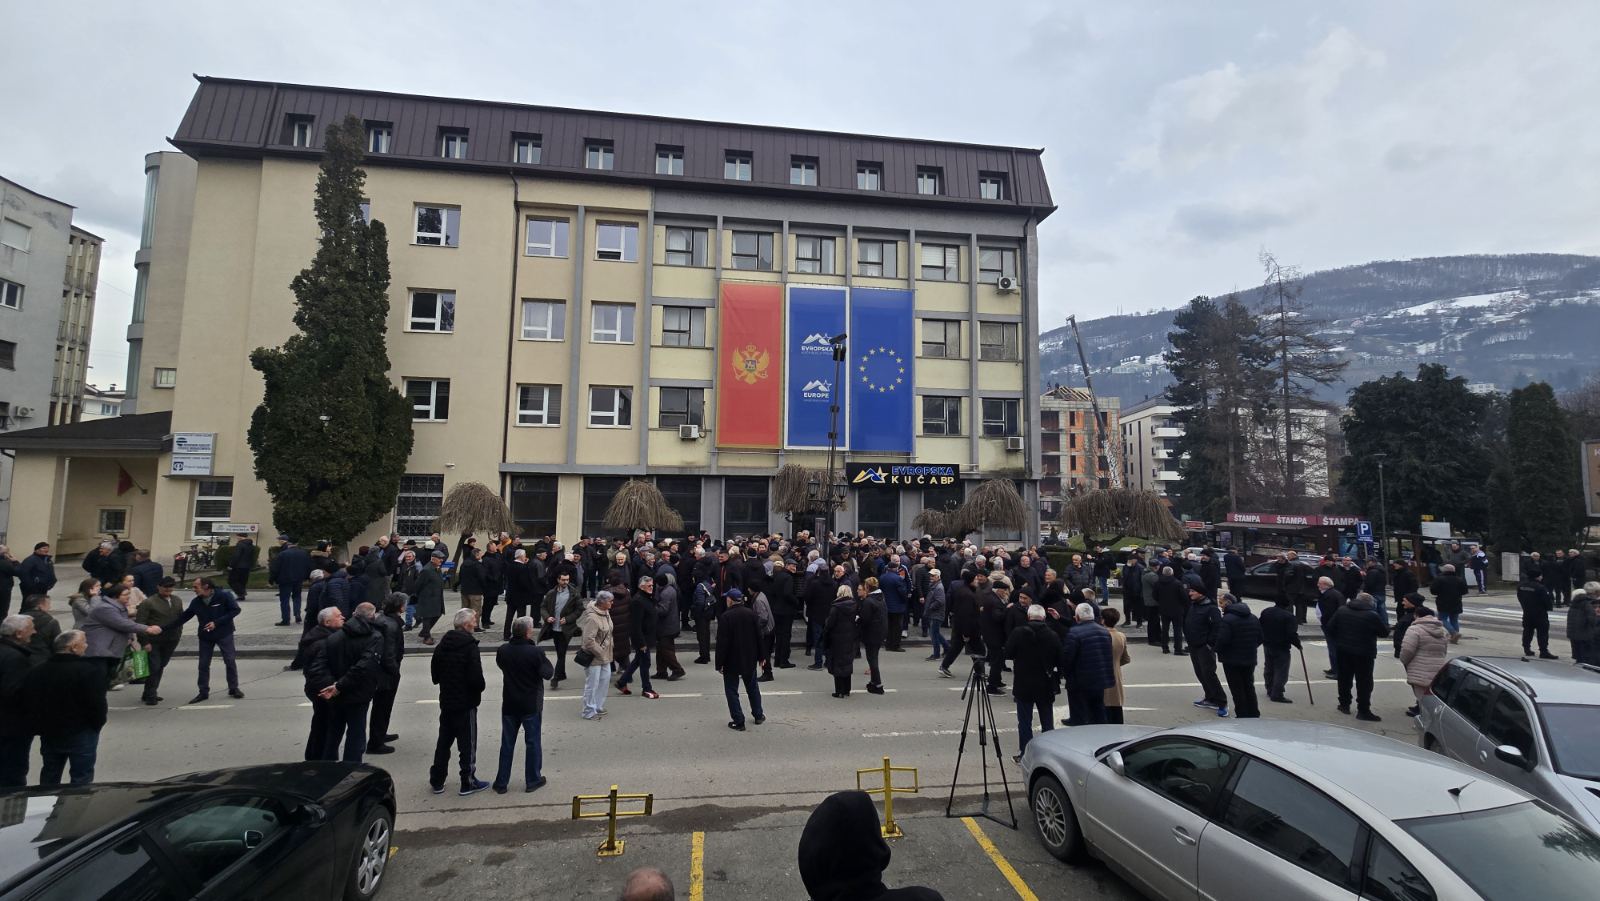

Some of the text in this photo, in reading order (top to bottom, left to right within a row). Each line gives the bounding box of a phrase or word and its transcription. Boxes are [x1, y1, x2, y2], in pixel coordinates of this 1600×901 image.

[892, 466, 954, 475] EVROPSKA
[1234, 513, 1359, 526] ŠTAMPA ŠTAMPA ŠTAMPA
[1360, 523, 1369, 535] P
